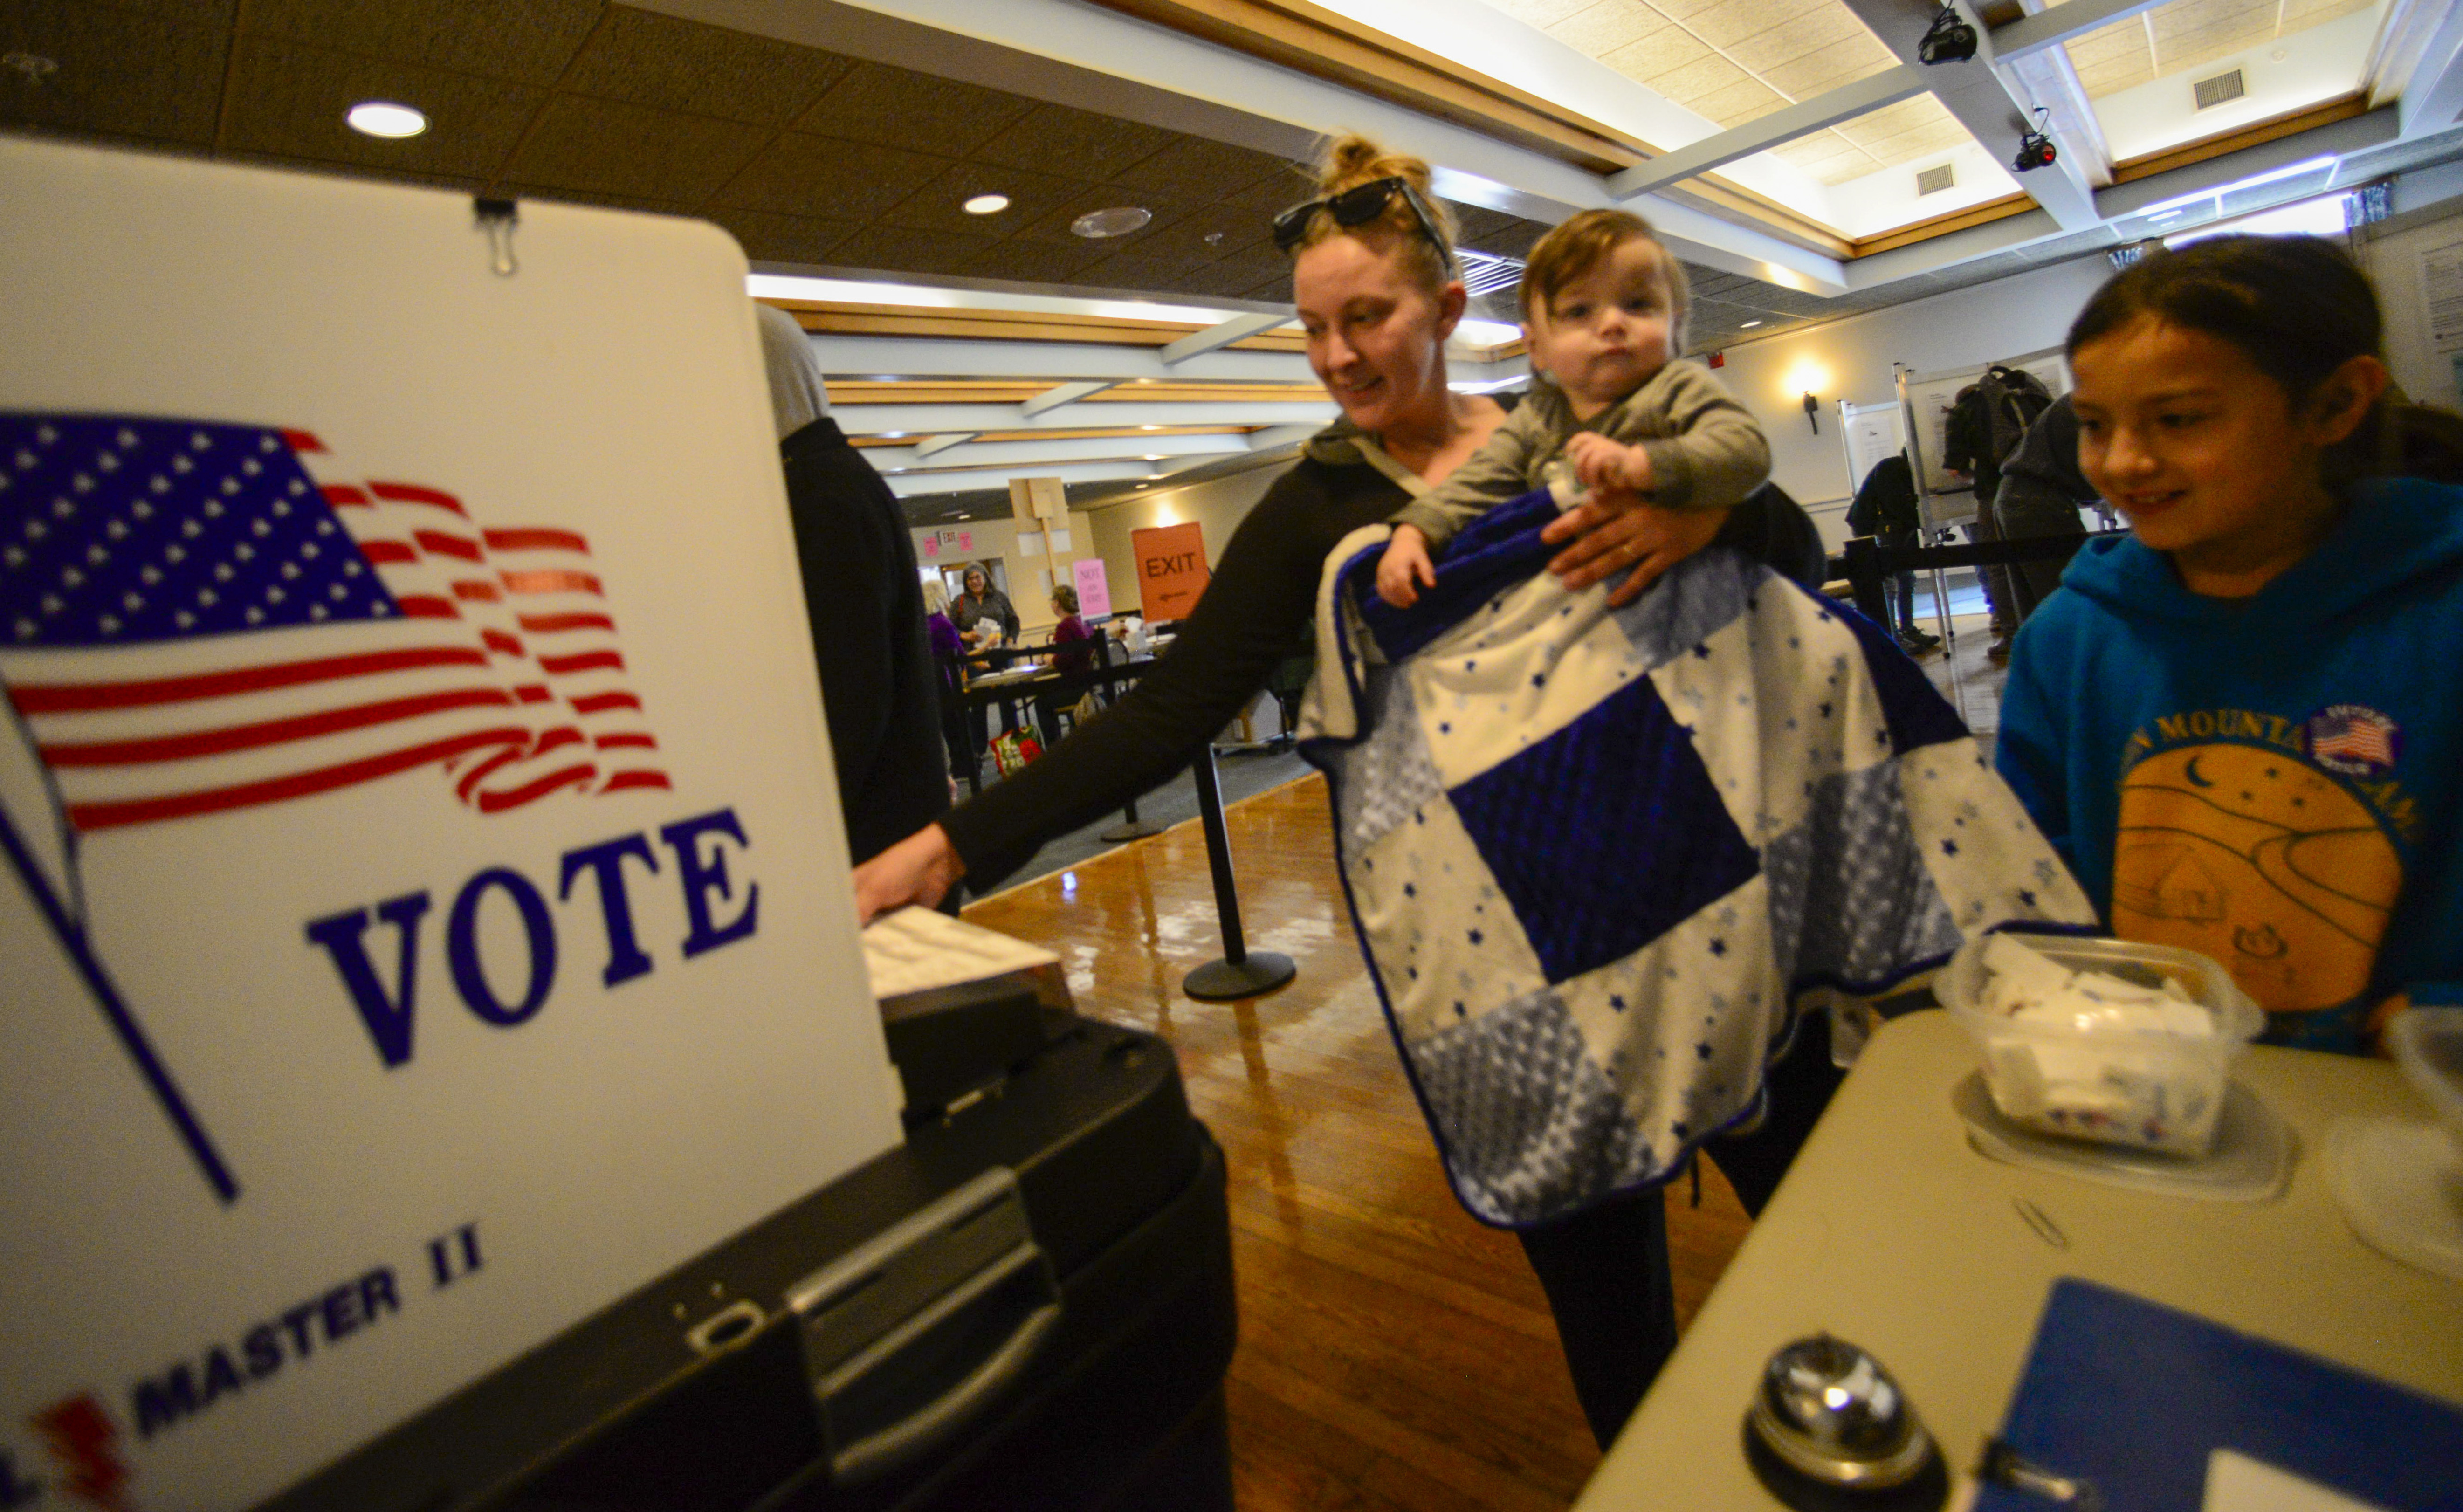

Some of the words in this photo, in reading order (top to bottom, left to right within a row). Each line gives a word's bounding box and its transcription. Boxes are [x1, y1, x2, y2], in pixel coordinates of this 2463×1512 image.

[1146, 552, 1195, 578] EXIT
[2155, 708, 2305, 752] MOUNTA
[303, 806, 759, 1070] VOTE
[131, 1265, 401, 1441] MASTER
[426, 1221, 482, 1288] II
